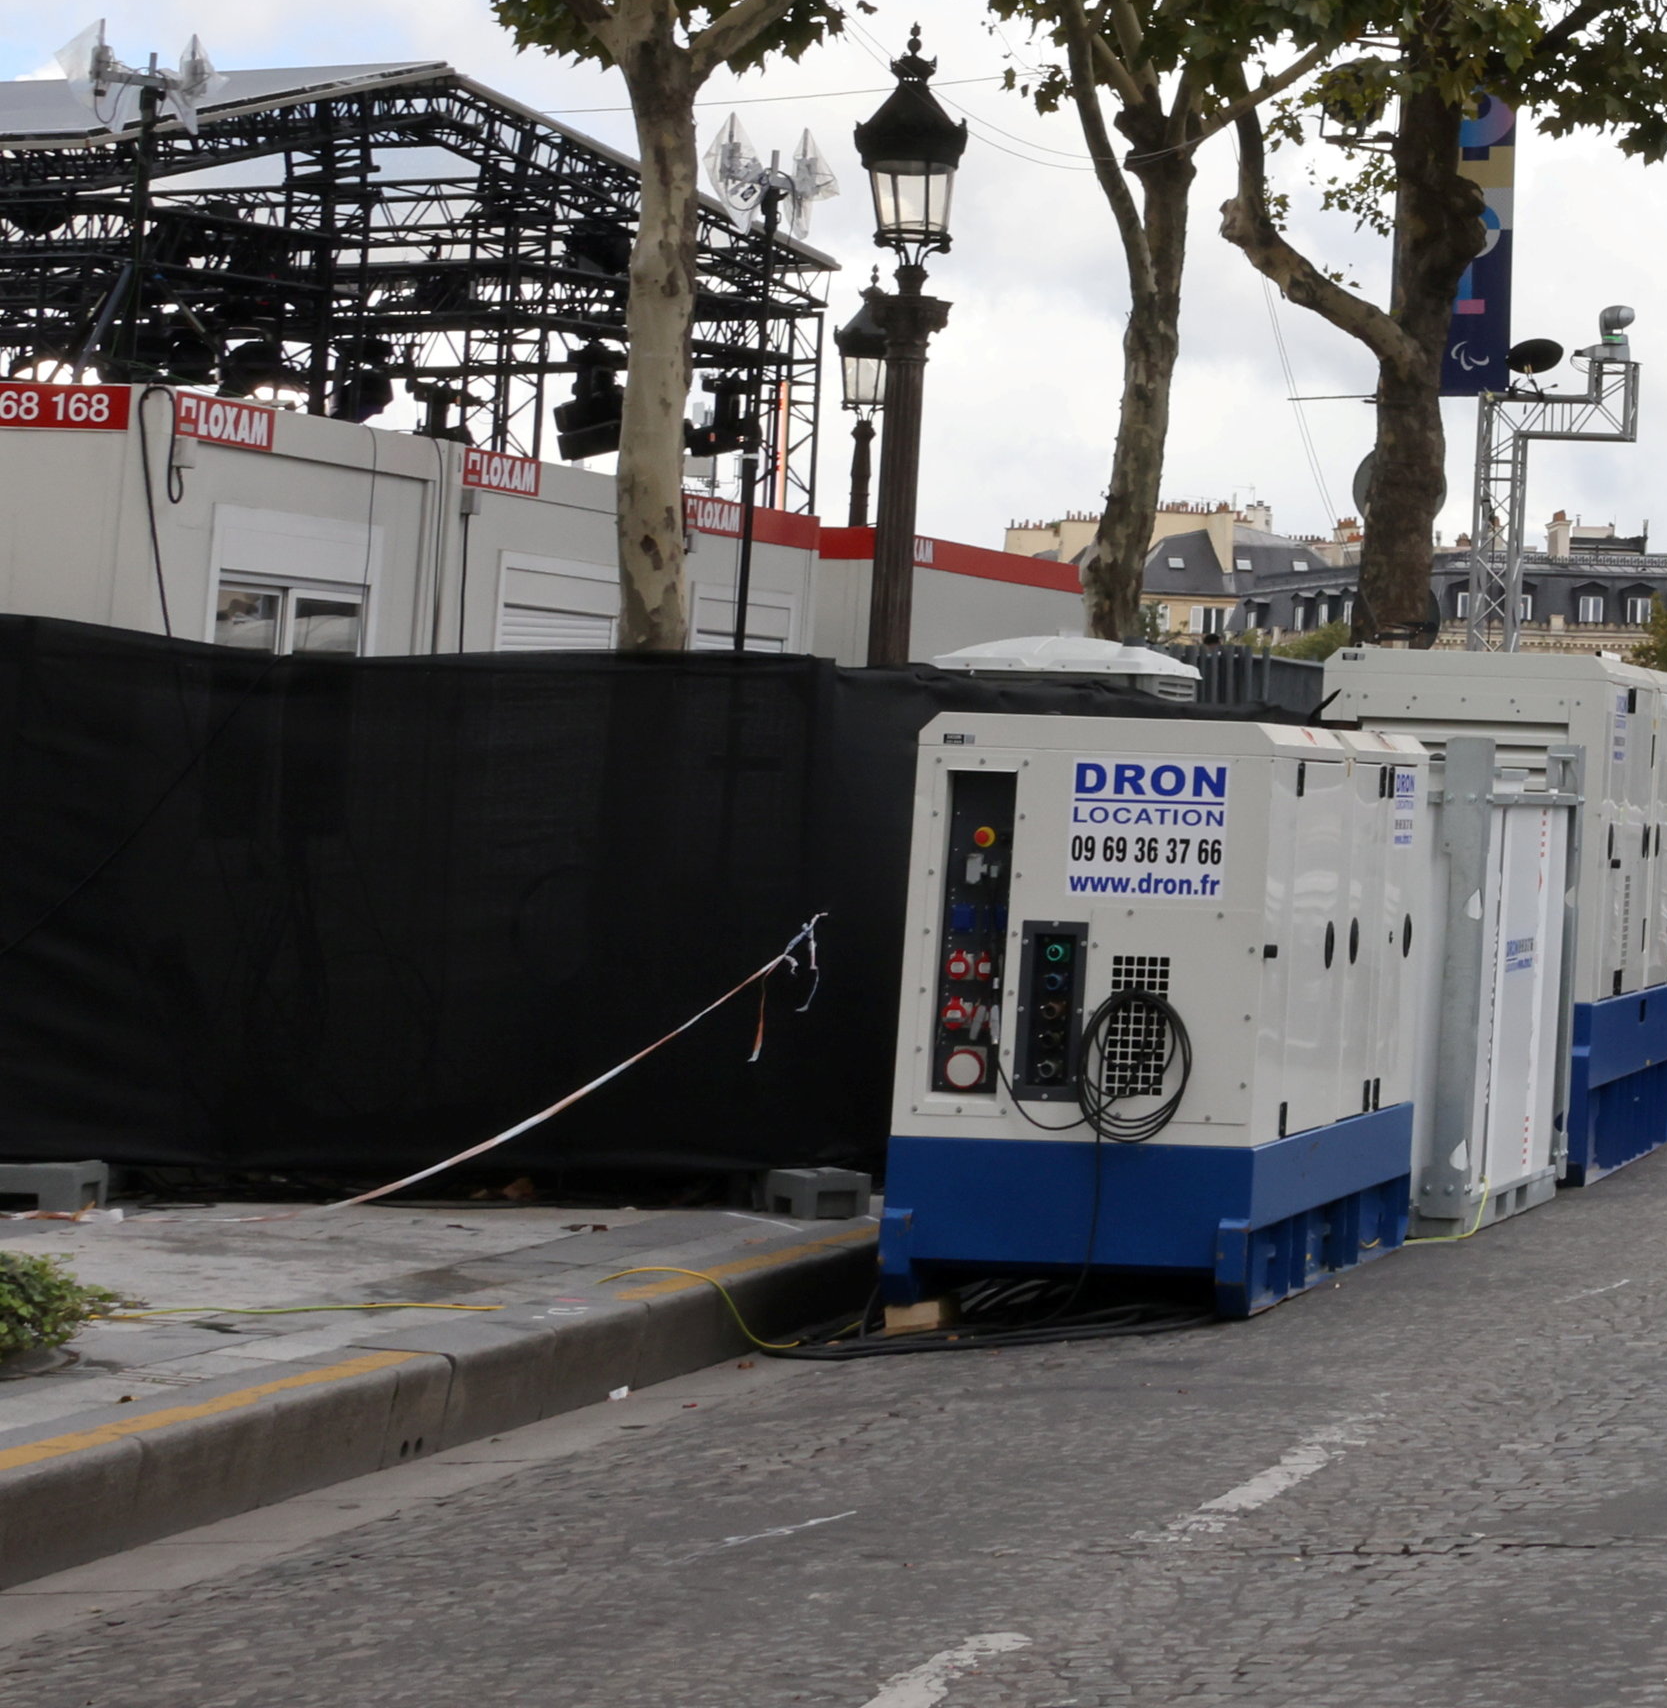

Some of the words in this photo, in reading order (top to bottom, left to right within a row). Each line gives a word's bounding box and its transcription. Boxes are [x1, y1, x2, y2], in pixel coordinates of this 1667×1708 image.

[51, 392, 110, 422] 168
[197, 400, 269, 447] LOXAM
[481, 452, 536, 493] LOXAM
[697, 496, 741, 533] LOXAM
[1075, 762, 1227, 798] DRON
[1073, 806, 1224, 827] LOCATION
[1071, 835, 1096, 861] 09
[1102, 836, 1127, 862] 69
[1134, 837, 1159, 863] 36
[1166, 838, 1190, 864] 37
[1197, 839, 1222, 865] 66
[1069, 872, 1220, 896] www.dron.fr
